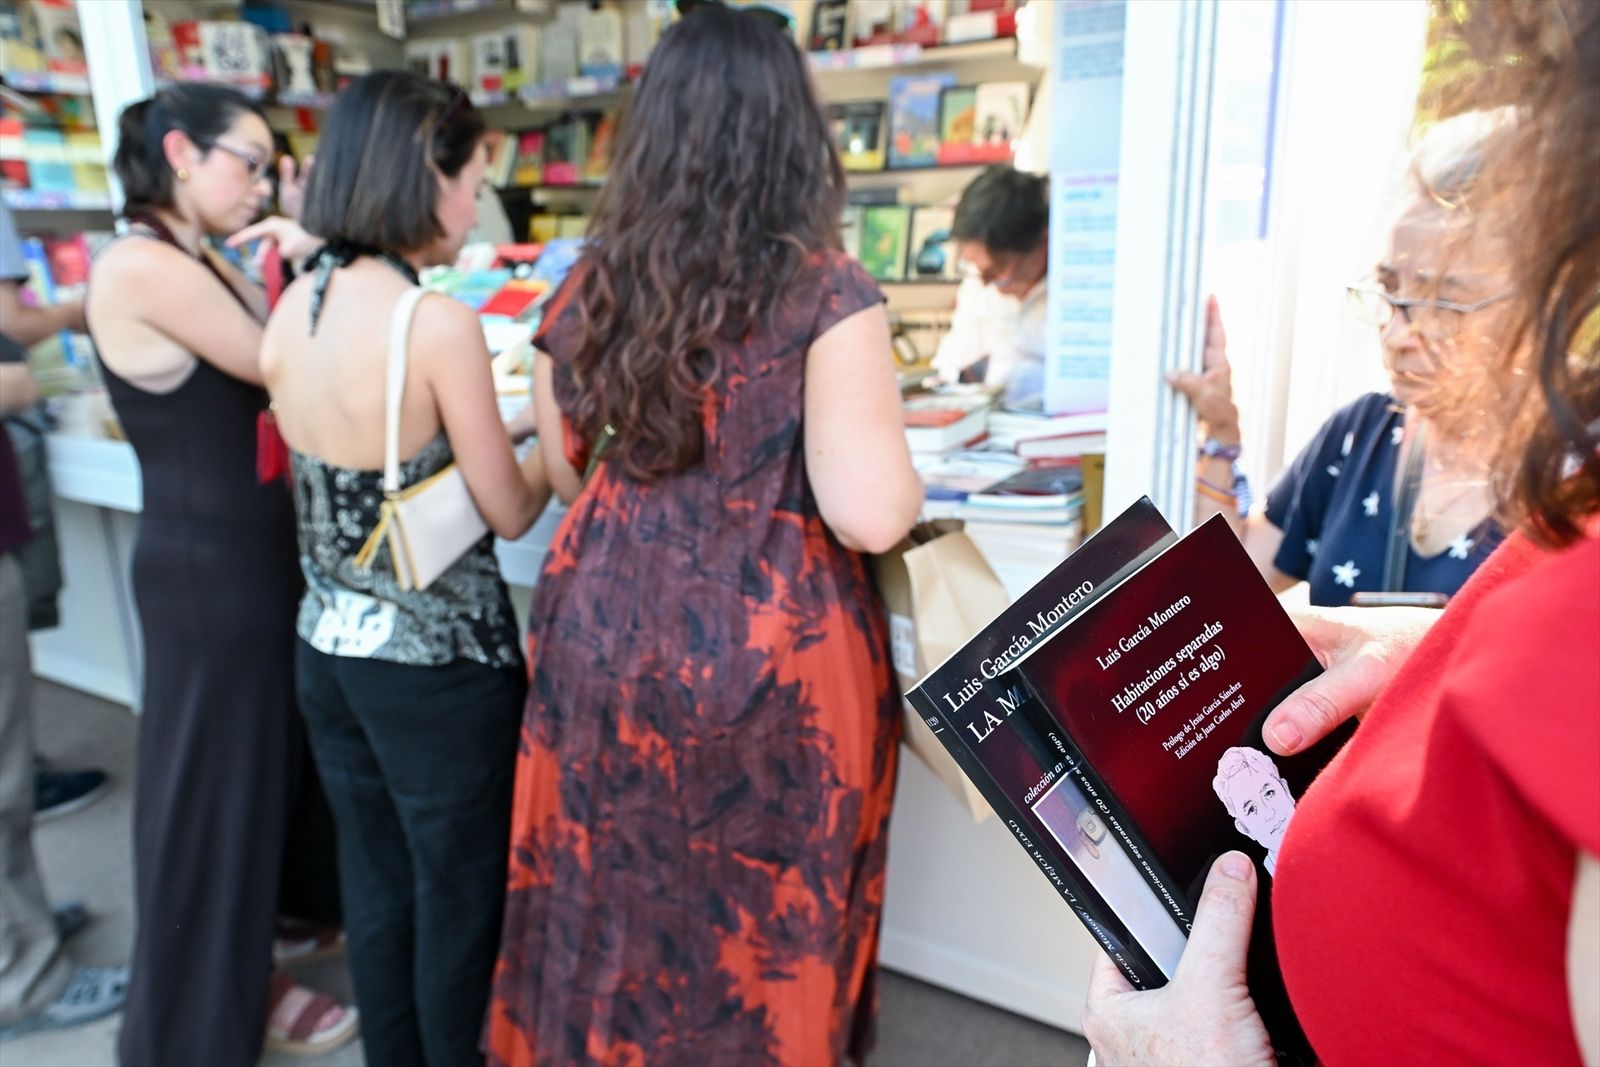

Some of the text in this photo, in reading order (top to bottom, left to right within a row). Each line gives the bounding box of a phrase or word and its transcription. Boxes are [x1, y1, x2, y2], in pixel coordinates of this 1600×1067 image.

[943, 580, 1094, 712] Luis García Montero
[1096, 595, 1191, 670] Luis García Montero
[1111, 621, 1223, 713] Habitaciones separadas
[1136, 644, 1225, 725] (20 años sí es algo)
[966, 710, 1003, 743] LA
[1162, 682, 1242, 751] Prólogo de Jesús García Sánchez
[1174, 694, 1246, 759] Edición de Juan Carlos Abril
[1049, 732, 1066, 753] algo)
[1065, 755, 1074, 765] es
[1024, 772, 1055, 804] colección
[1081, 776, 1098, 797] años
[1095, 799, 1110, 814] (20
[1008, 819, 1033, 848] EDAD
[1109, 815, 1143, 859] separadas
[1033, 850, 1064, 886] MEJOR
[1064, 888, 1077, 903] LA
[1141, 860, 1184, 917] Habitaciones
[1082, 911, 1115, 952] Montero
[1114, 953, 1140, 984] García
